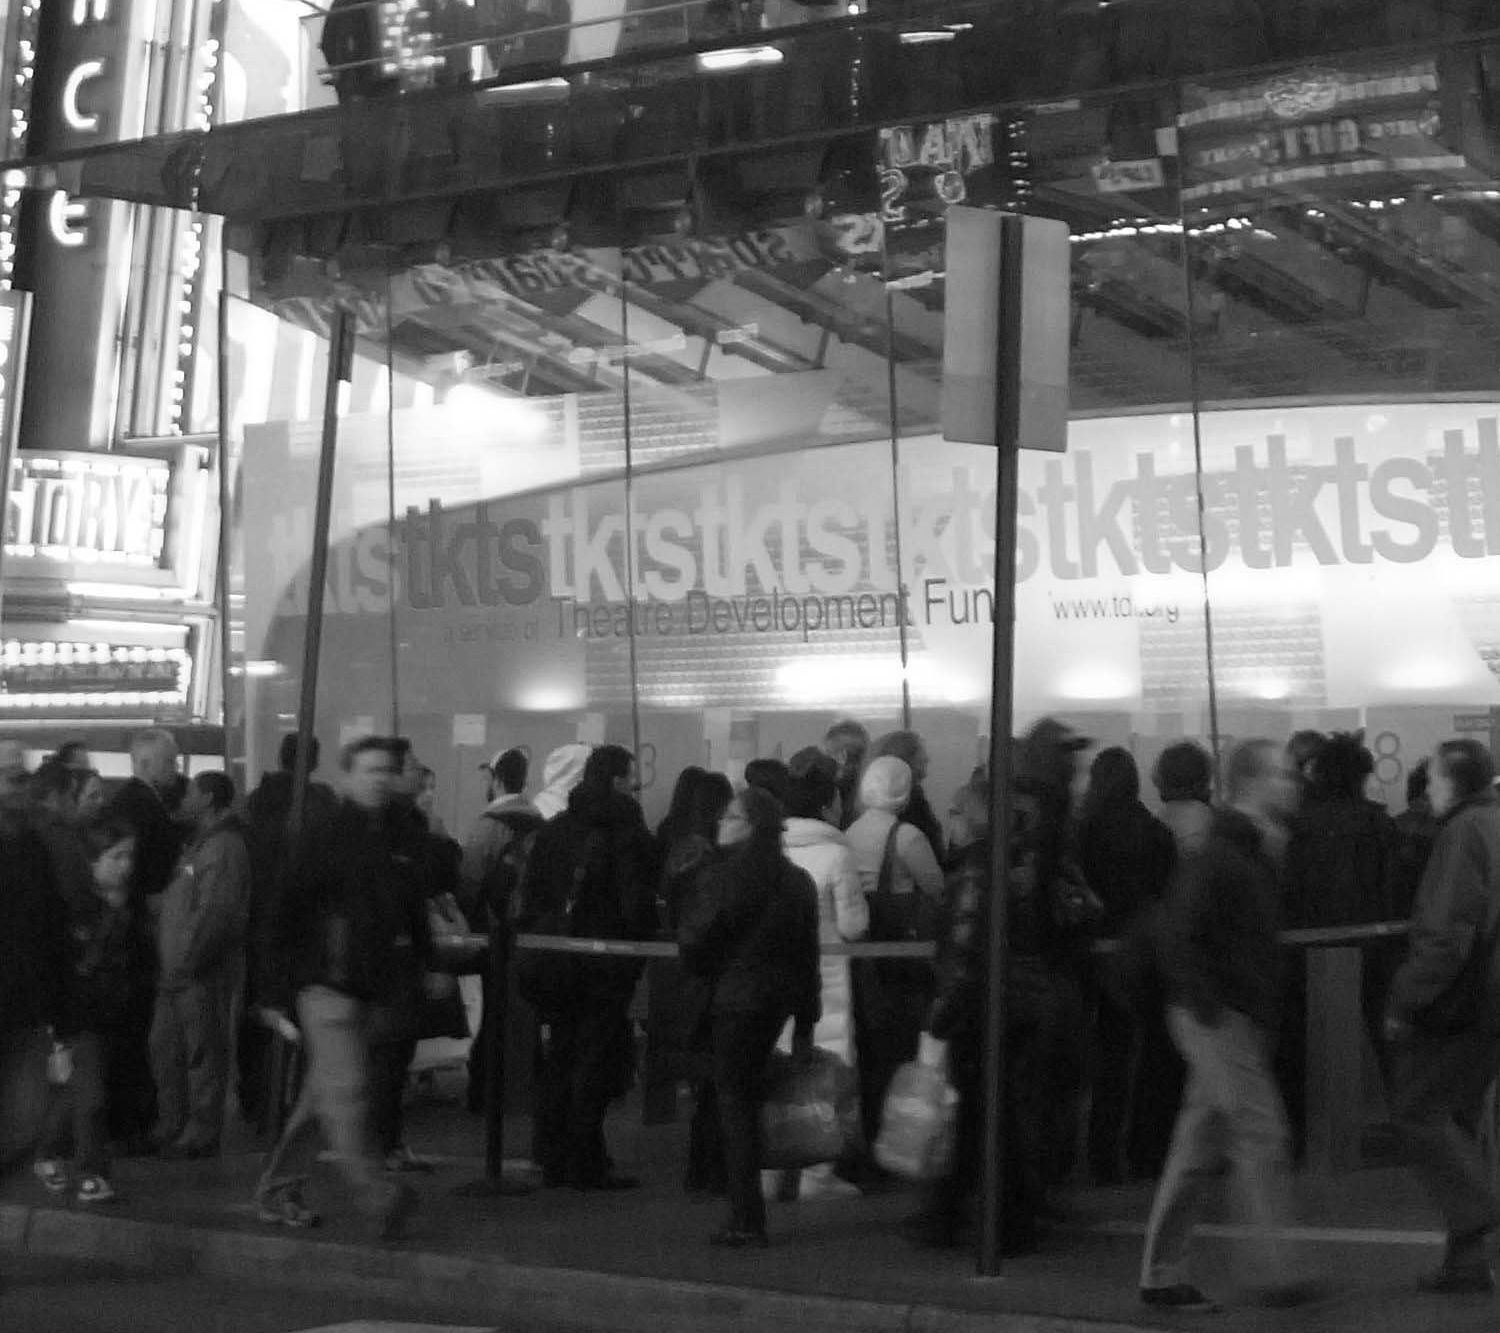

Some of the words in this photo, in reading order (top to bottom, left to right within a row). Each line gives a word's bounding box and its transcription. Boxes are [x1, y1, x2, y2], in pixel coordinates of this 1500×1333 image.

[400, 497, 546, 610] tkts
[542, 486, 698, 602] tkts
[695, 474, 862, 596] tkts
[1037, 448, 1231, 581] tkts
[1232, 435, 1438, 572] tkts
[550, 594, 674, 638] Theatre
[687, 582, 915, 643] Development
[925, 577, 1017, 625] Fun
